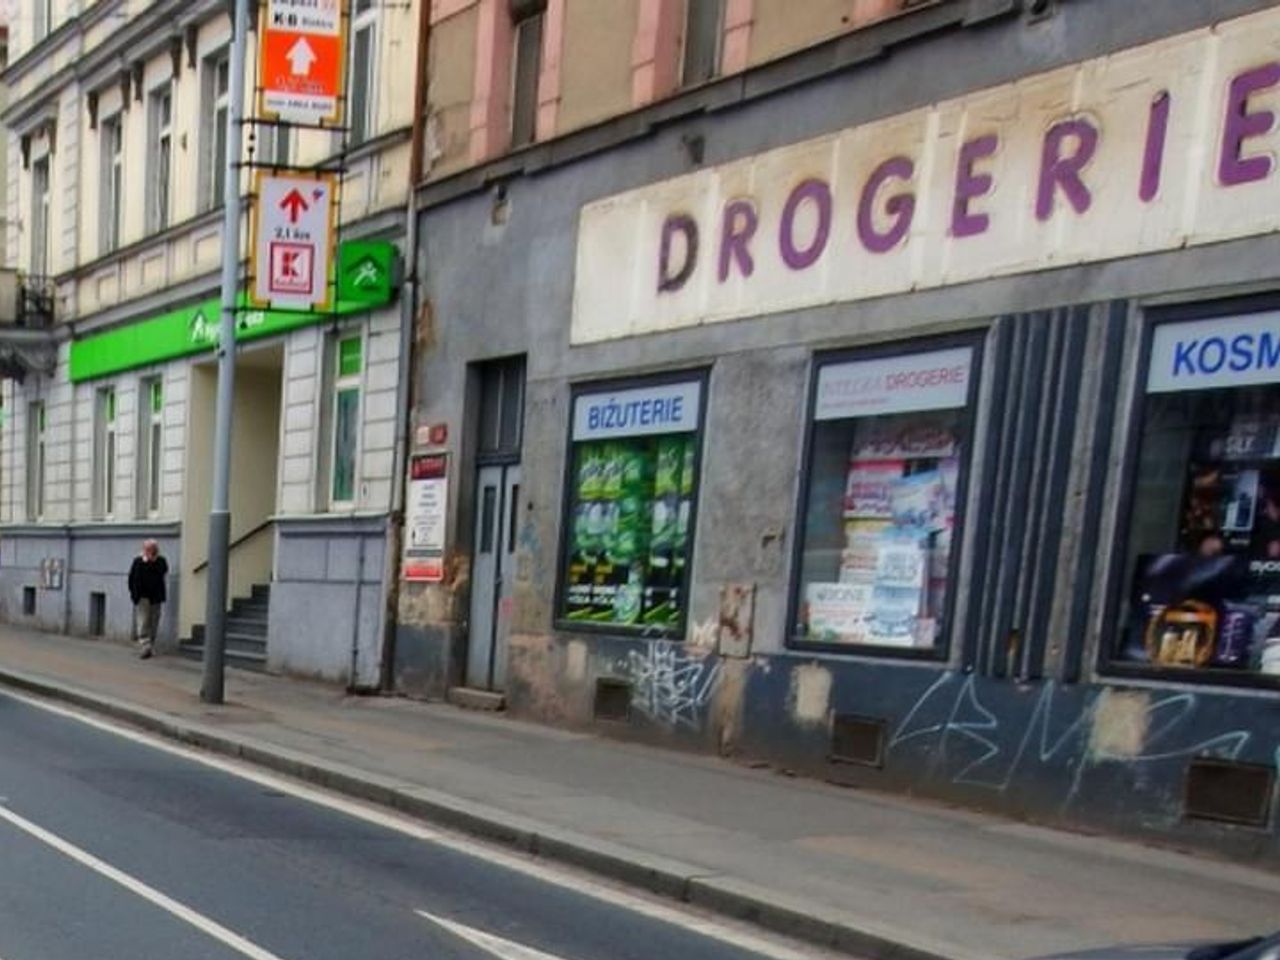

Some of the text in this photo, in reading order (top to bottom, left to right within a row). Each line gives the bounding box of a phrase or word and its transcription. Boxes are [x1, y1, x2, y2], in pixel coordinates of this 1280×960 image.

[656, 62, 1280, 294] DROGERIE
[1171, 332, 1280, 377] KOSM
[885, 366, 965, 392] DROGERIE
